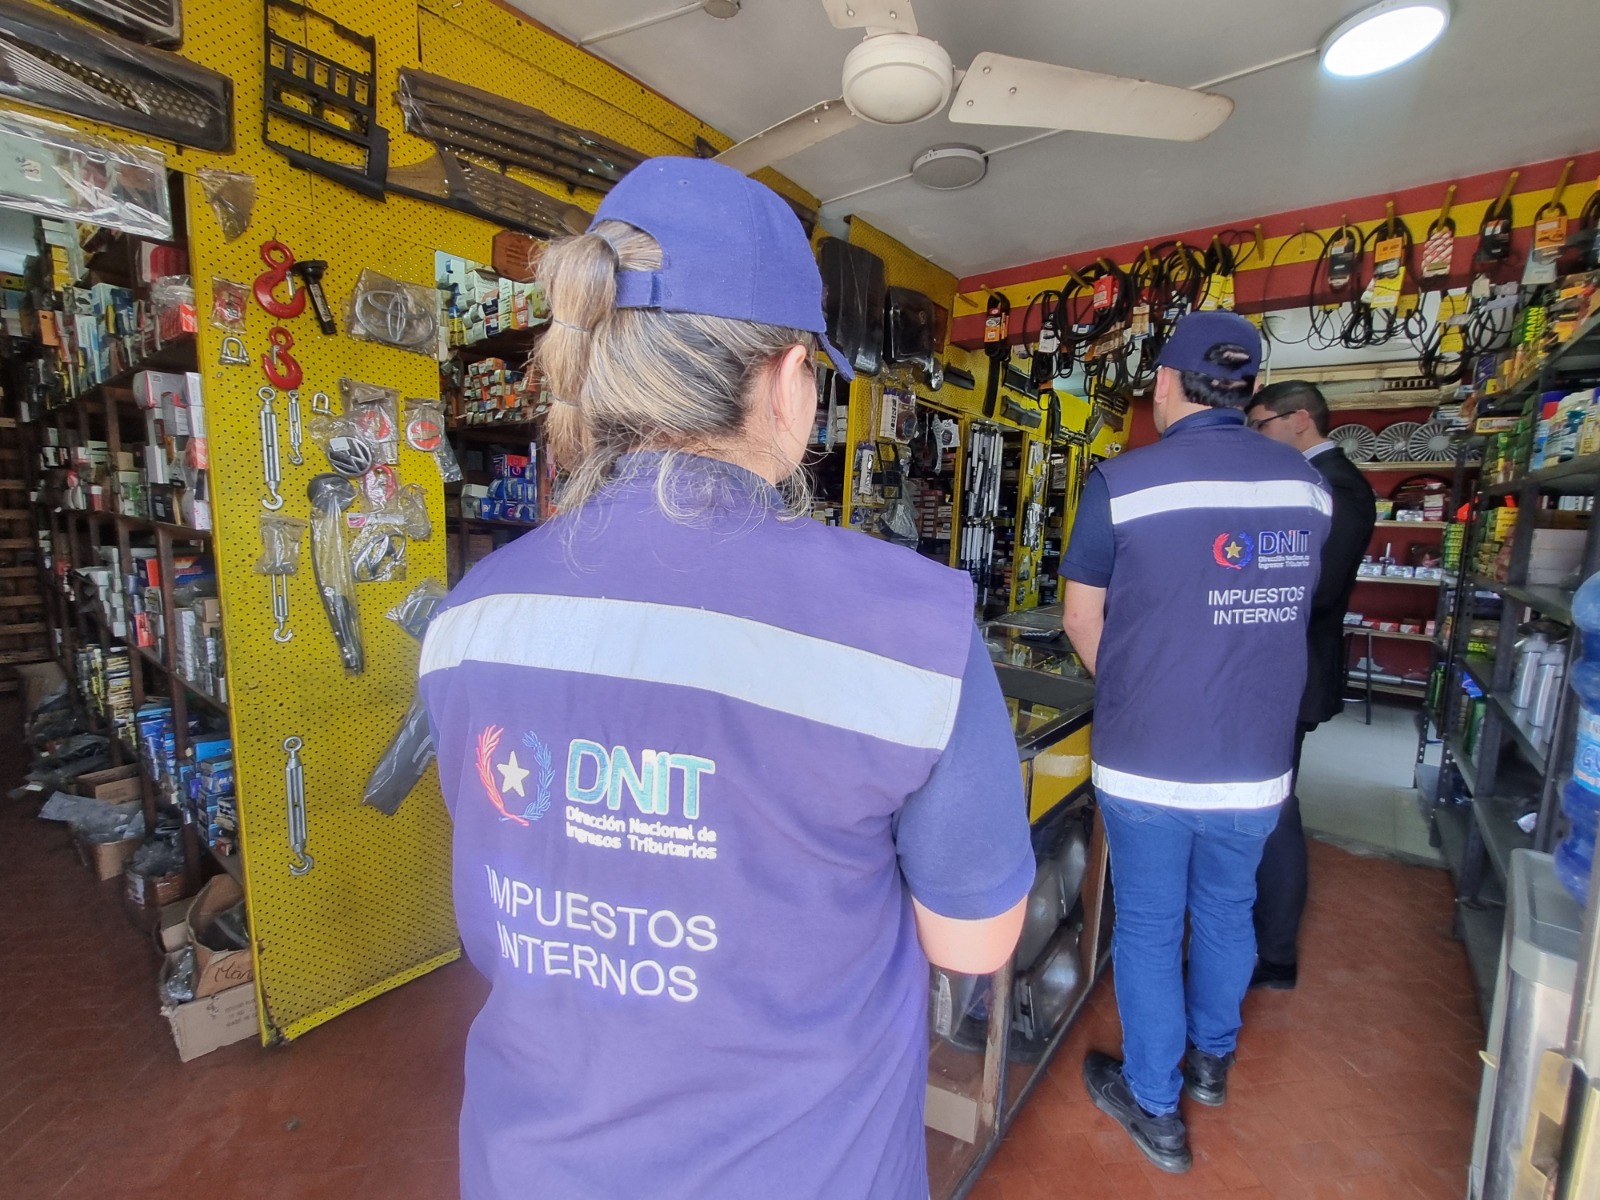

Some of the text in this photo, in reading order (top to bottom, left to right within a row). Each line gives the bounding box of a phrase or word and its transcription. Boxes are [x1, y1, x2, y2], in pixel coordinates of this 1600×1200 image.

[1258, 530, 1311, 554] DNIT
[1208, 586, 1305, 606] IMPUESTOS
[1213, 605, 1299, 625] INTERNOS
[566, 738, 716, 820] DNIT
[565, 805, 717, 842] Dirección Nacional de
[627, 834, 718, 859] Tributarios
[484, 864, 718, 951] IMPUESTOS
[497, 920, 699, 1003] INTERNOS
